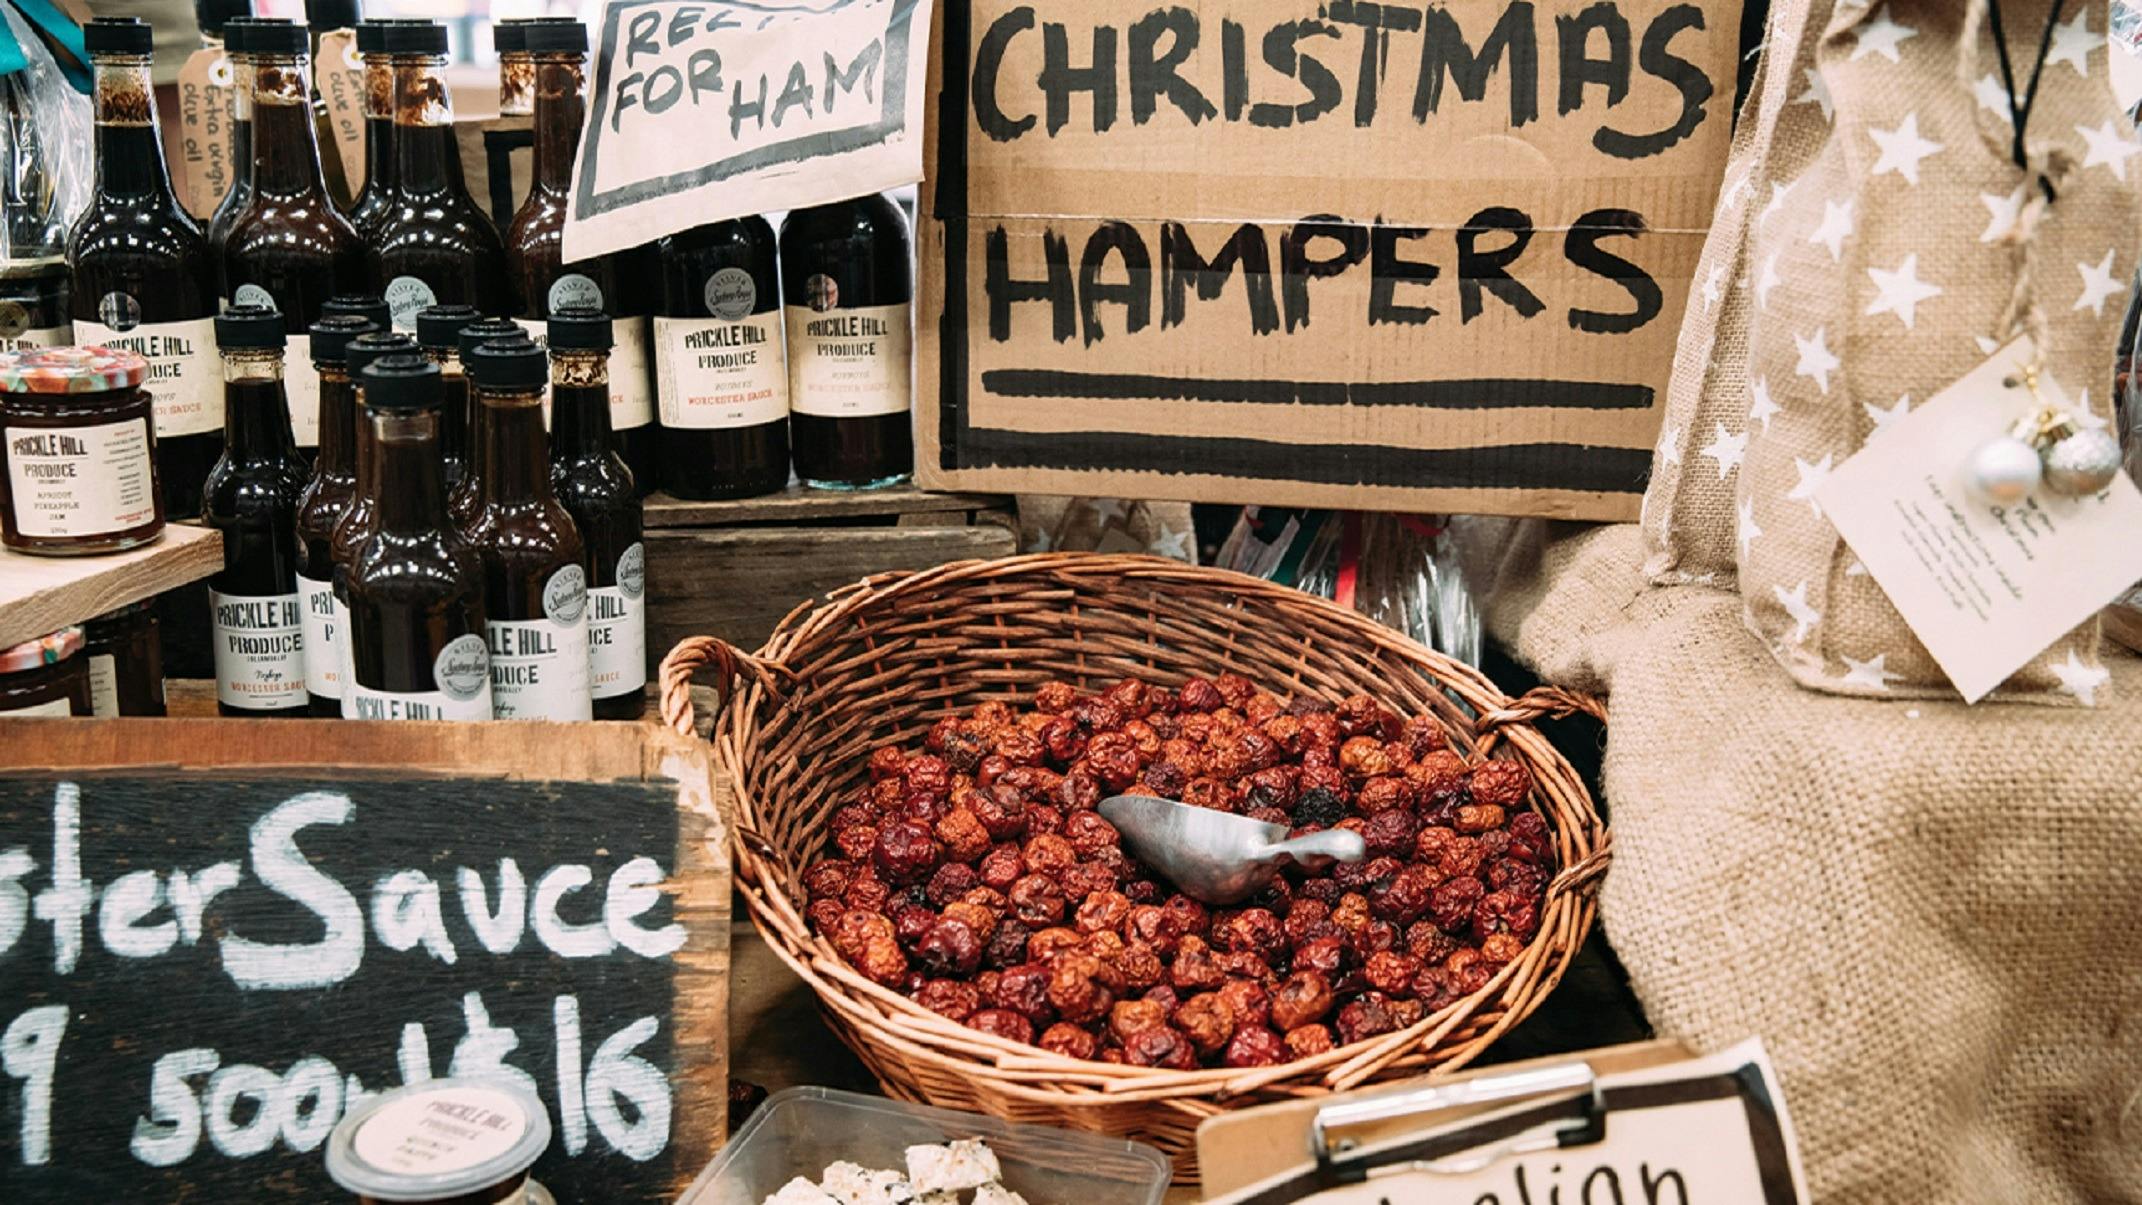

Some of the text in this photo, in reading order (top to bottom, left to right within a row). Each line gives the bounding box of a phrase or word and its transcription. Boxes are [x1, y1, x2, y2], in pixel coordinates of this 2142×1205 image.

[627, 7, 746, 68] REC
[612, 38, 882, 140] FOR HAM
[972, 0, 1715, 159] CHRISTMAS
[340, 119, 360, 143] oil
[186, 138, 203, 162] oil
[985, 206, 1664, 348] HAMPERS
[685, 324, 767, 349] PRICKLE HILL
[806, 315, 889, 337] PRICKLE HILL
[163, 336, 194, 356] HILL
[817, 342, 877, 357] PRODUCE
[697, 350, 758, 369] PRODUCE
[12, 434, 88, 457] PRICKLE HILL
[24, 463, 77, 478] PRODUCE
[217, 602, 279, 629] PRICKLE
[282, 602, 301, 627] HI
[596, 594, 627, 620] HILL
[228, 634, 304, 655] PRODUCE
[518, 627, 557, 657] HILL
[492, 665, 539, 686] DUCE
[219, 791, 689, 990] Sauce
